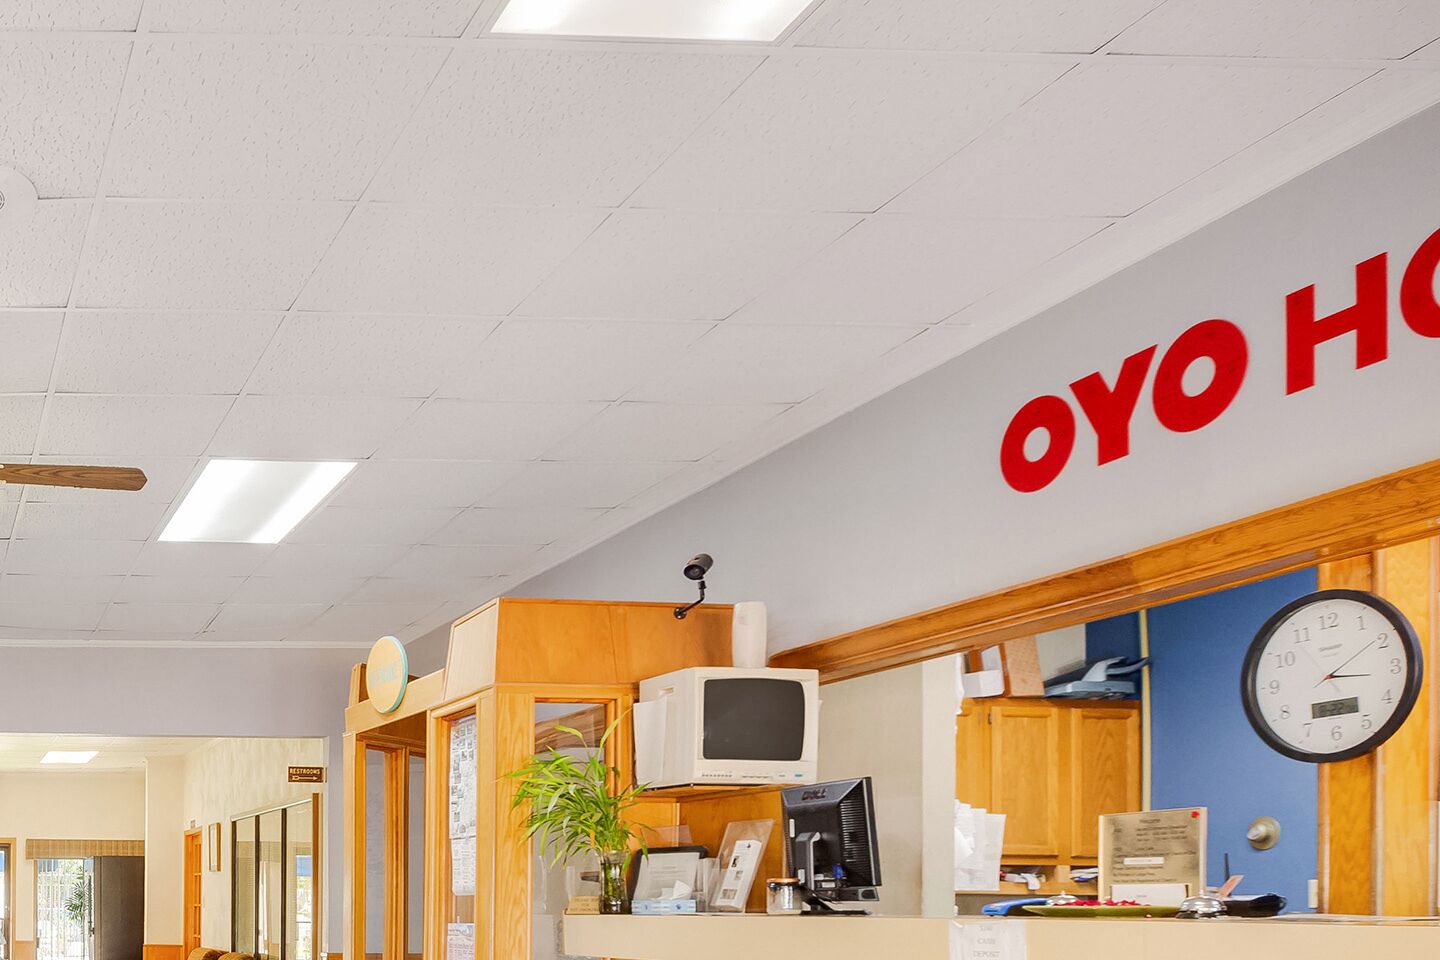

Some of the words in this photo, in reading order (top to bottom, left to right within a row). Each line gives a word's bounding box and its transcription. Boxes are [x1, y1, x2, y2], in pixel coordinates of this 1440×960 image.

[1000, 319, 1248, 493] OYO
[1317, 612, 1339, 631] 12
[1357, 615, 1367, 631] 1
[1293, 627, 1311, 644] 11
[1377, 632, 1389, 649] 2
[1275, 651, 1296, 669] 10
[1389, 657, 1402, 675] 3
[1269, 679, 1281, 695] 9
[1381, 689, 1393, 704] 4
[1280, 704, 1291, 720] 8
[1303, 722, 1313, 738] 7
[1361, 714, 1373, 730] 5
[1331, 725, 1343, 741] 6
[289, 767, 320, 775] RESTROOMS
